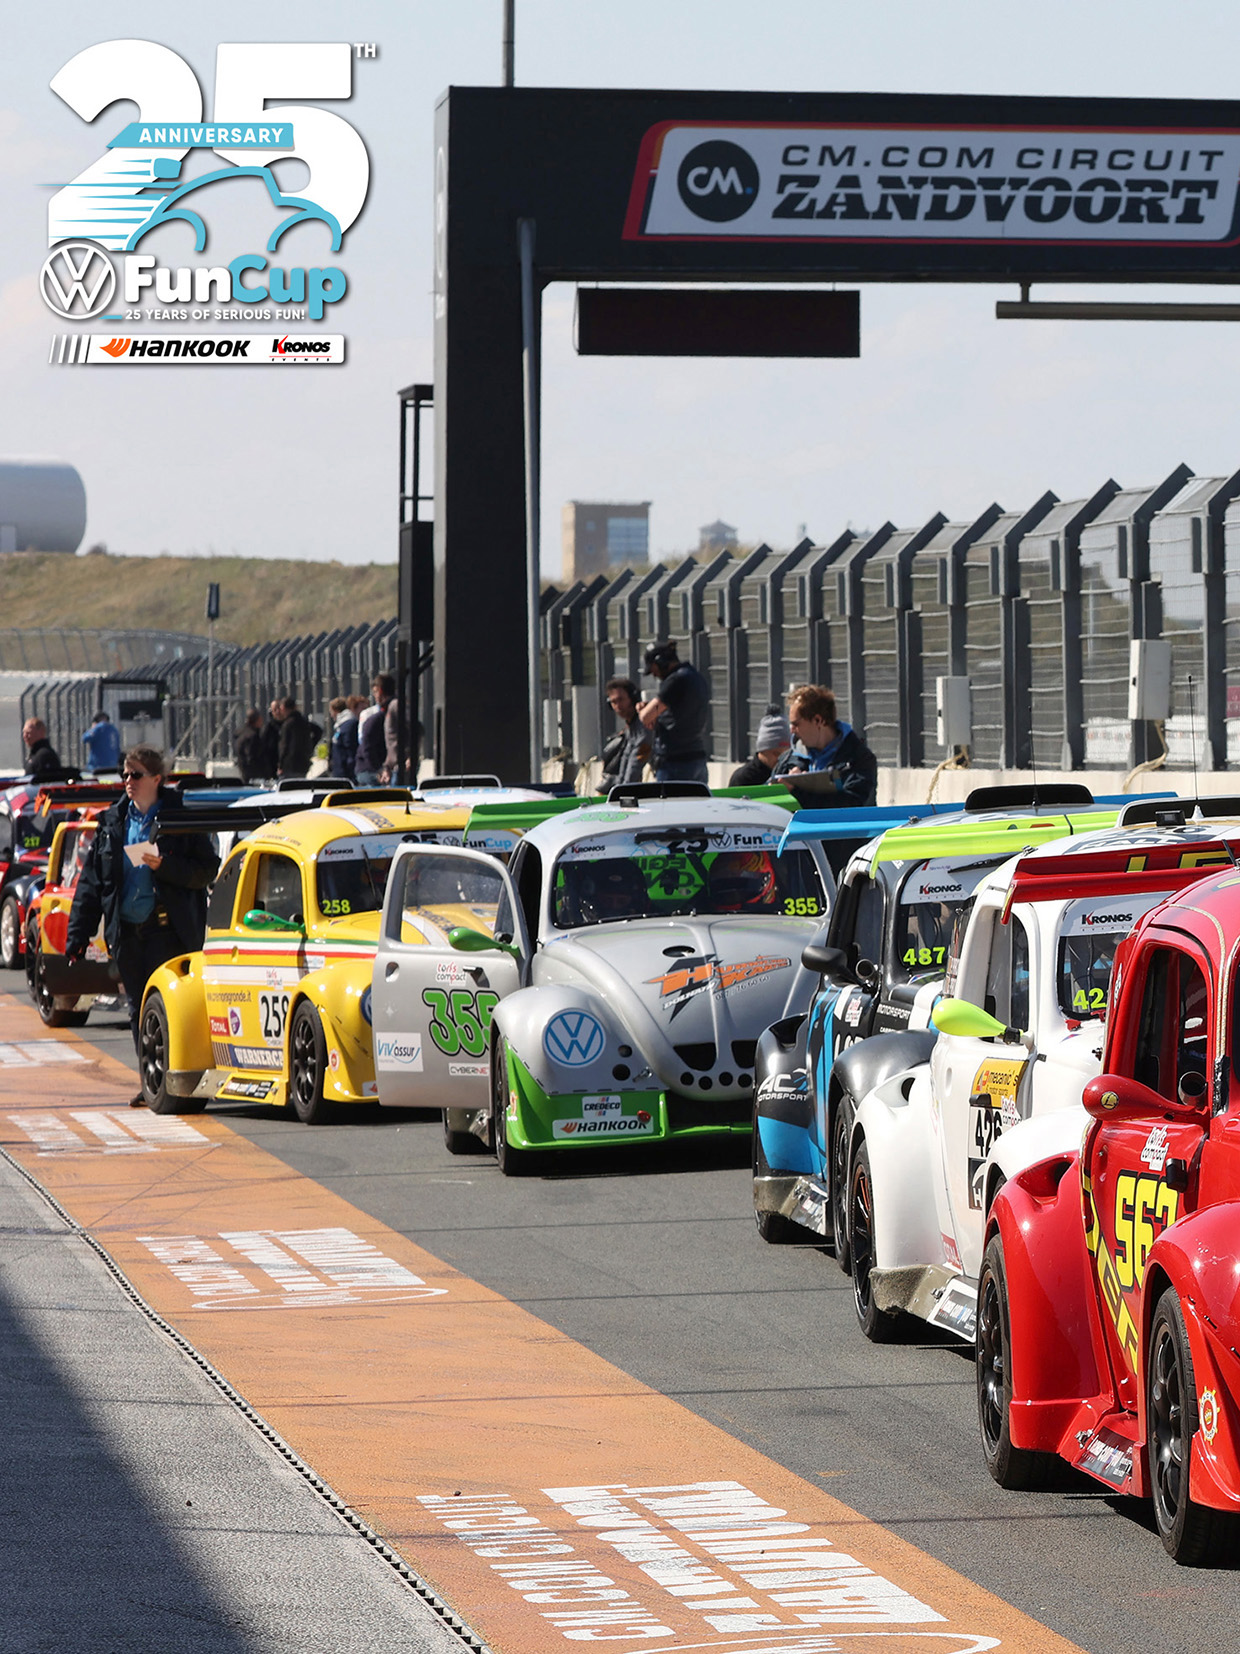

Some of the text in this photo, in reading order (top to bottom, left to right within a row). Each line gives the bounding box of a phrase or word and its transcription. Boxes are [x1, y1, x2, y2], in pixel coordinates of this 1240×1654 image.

[779, 144, 1225, 172] CM.COM CIRCUIT
[770, 174, 1220, 225] ZANDVOORT
[733, 833, 792, 849] FunCu
[571, 844, 606, 855] KRONOS
[919, 882, 962, 895] KRONOS
[322, 899, 350, 915] 258
[783, 897, 818, 916] 355
[1081, 911, 1133, 925] KRONOS
[903, 946, 946, 966] 487
[436, 972, 466, 984] compact
[1072, 987, 1108, 1010] 42
[876, 1002, 911, 1020] MOTORSPORT
[210, 1019, 228, 1033] TOTAL
[450, 1066, 489, 1076] CYBERNE
[757, 1092, 808, 1102] OTORSPORT
[584, 1101, 621, 1112] CREDECO
[415, 1492, 575, 1558] CIRCUIT
